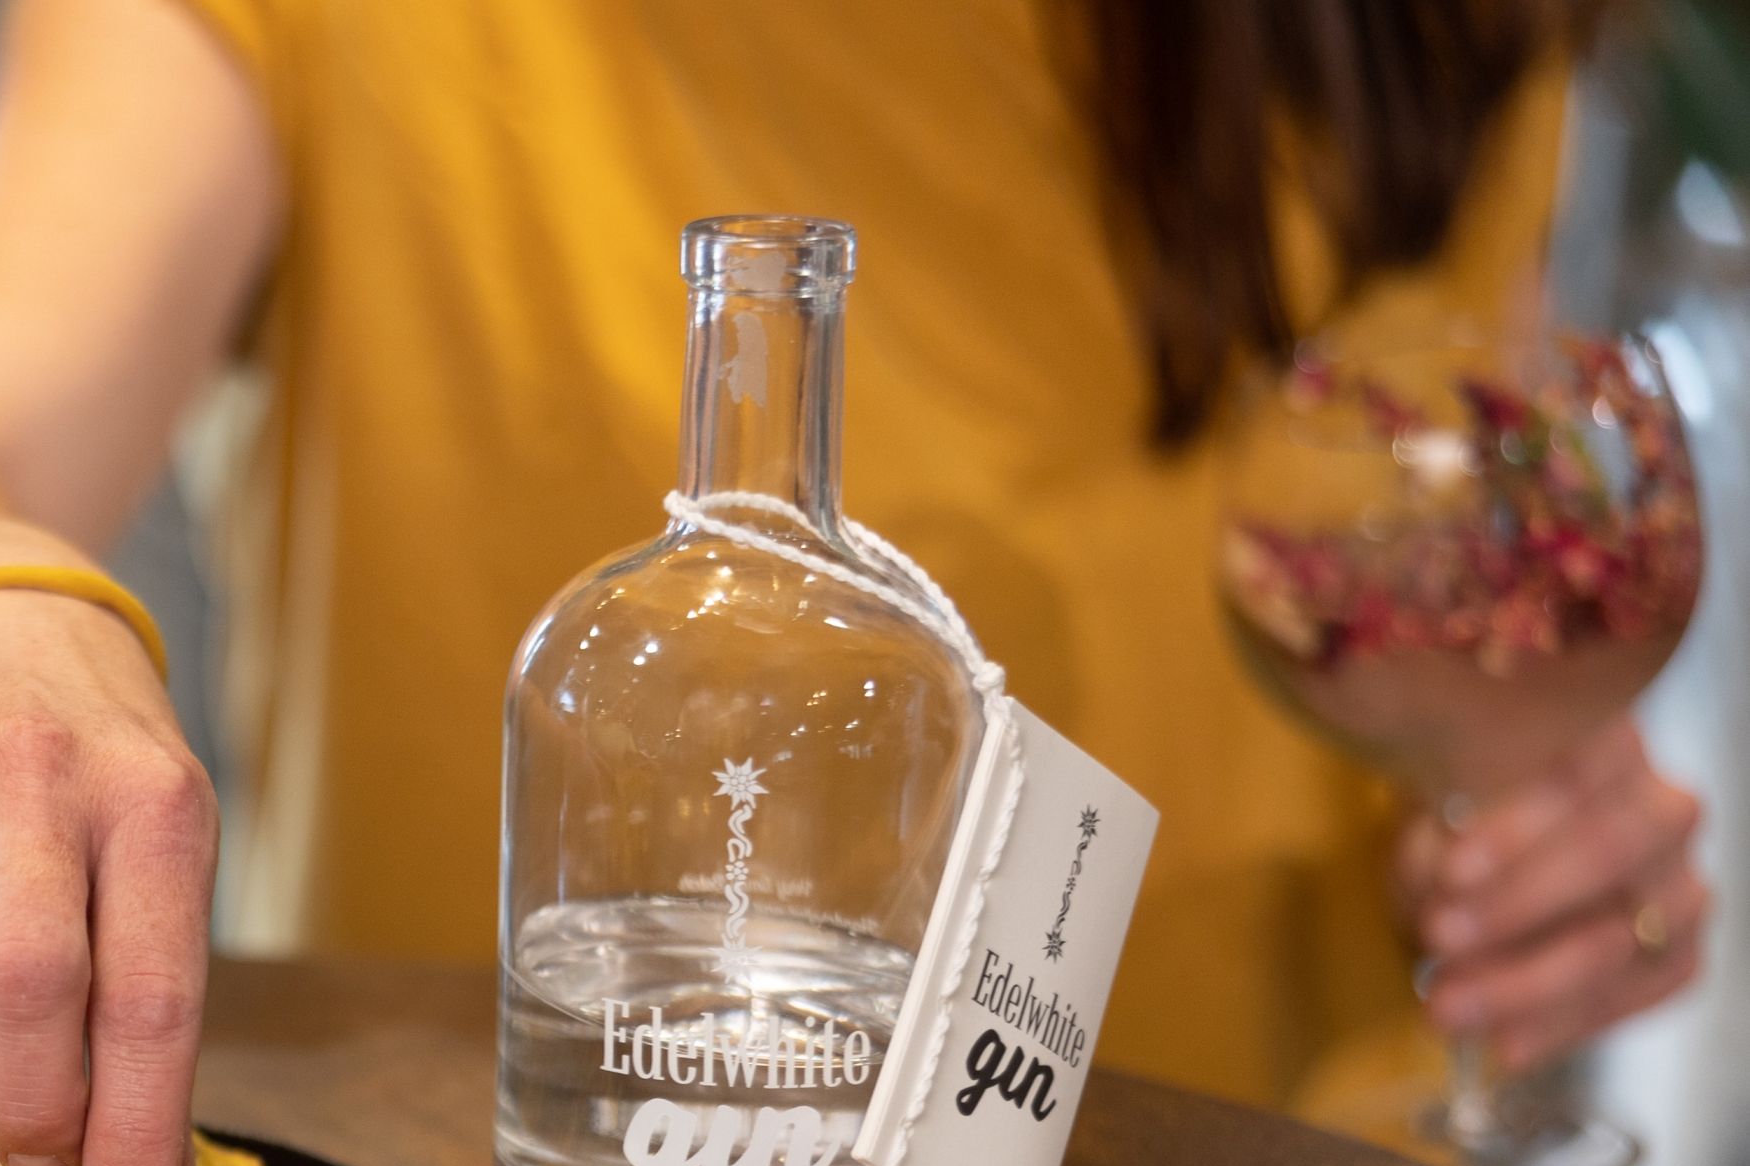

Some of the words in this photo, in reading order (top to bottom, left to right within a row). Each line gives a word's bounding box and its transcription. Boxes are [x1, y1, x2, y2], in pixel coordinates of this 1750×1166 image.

[600, 997, 871, 1089] Edelwhite
[971, 948, 1086, 1069] Edelwhite
[956, 1028, 1057, 1122] gin
